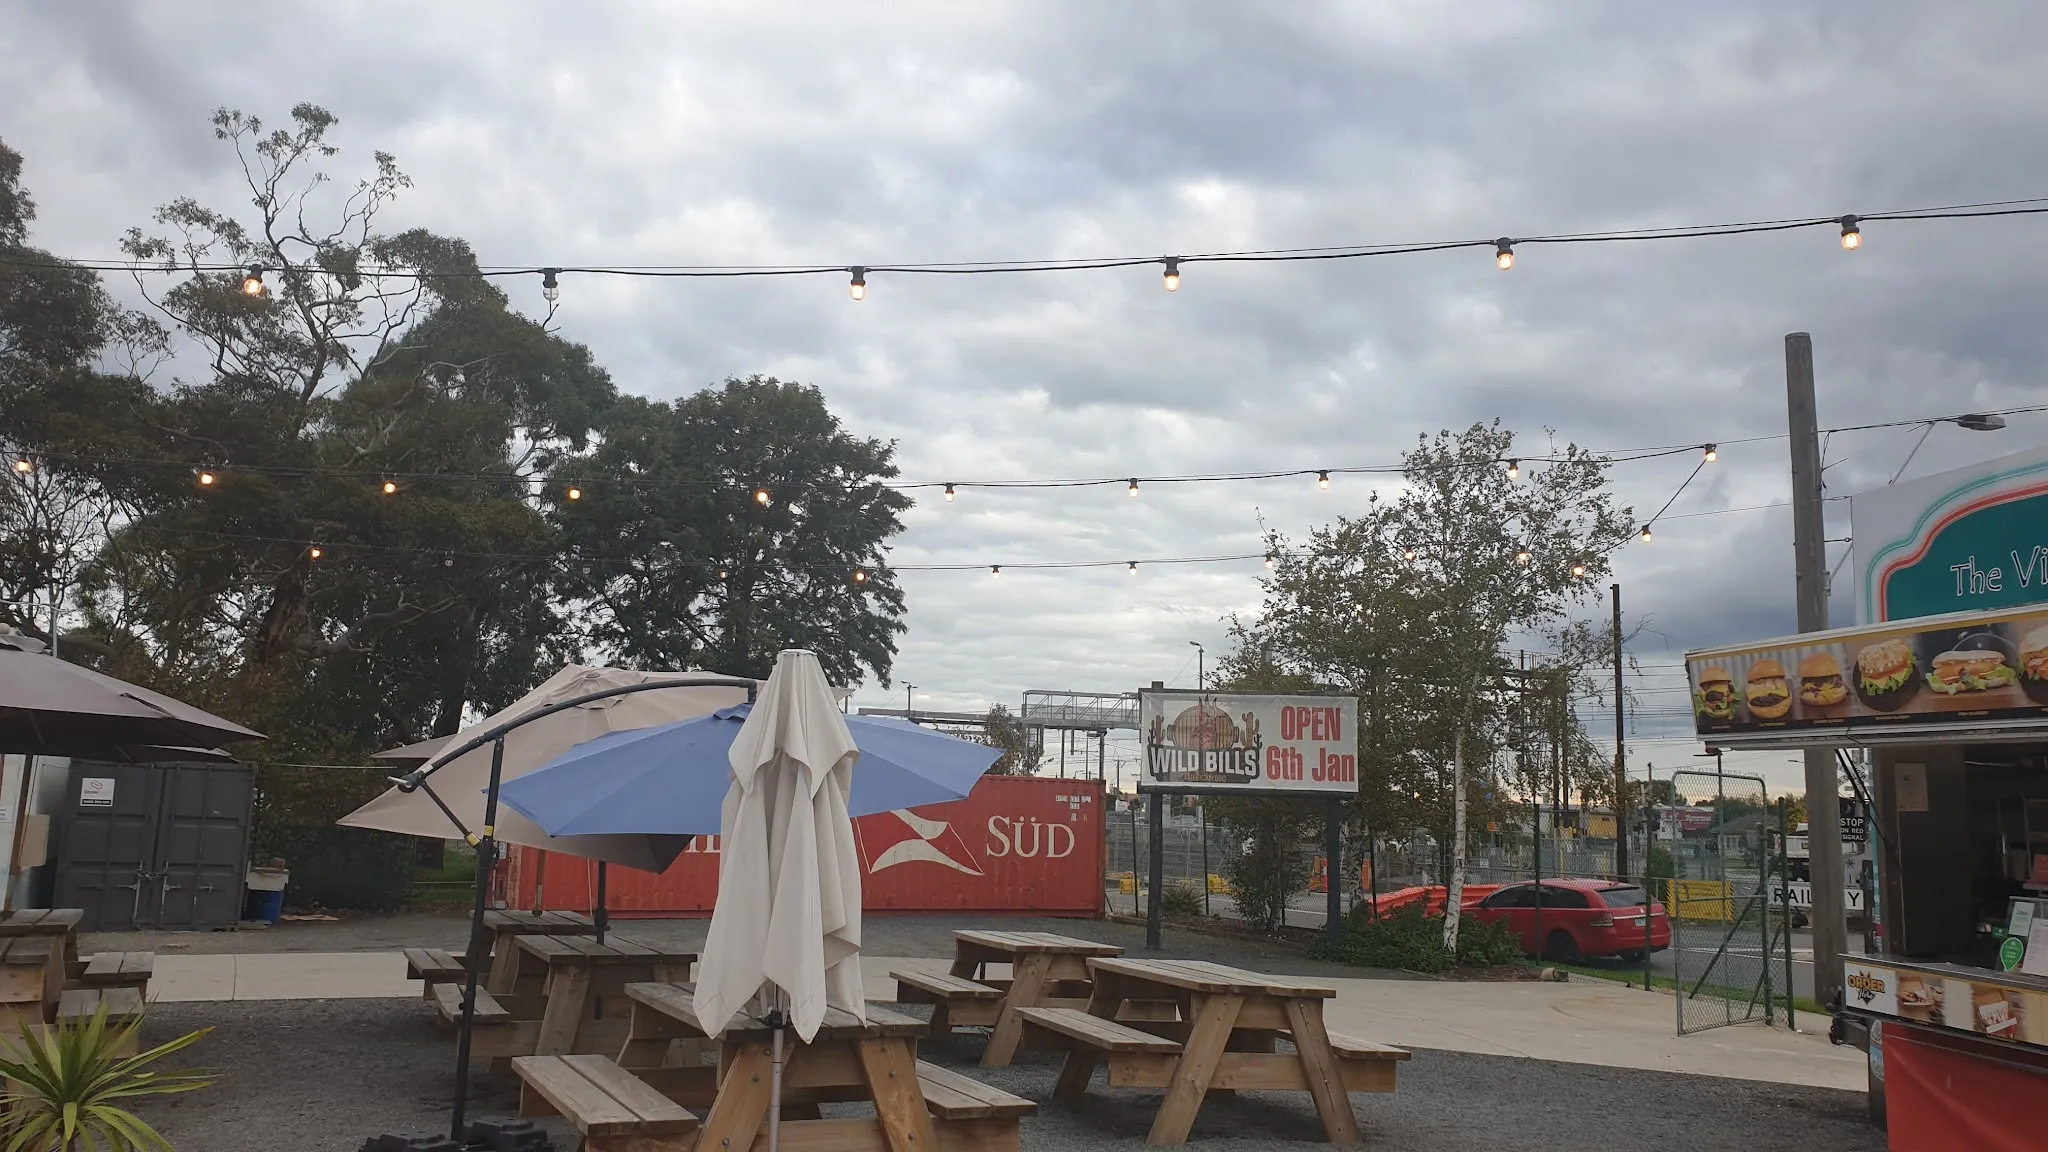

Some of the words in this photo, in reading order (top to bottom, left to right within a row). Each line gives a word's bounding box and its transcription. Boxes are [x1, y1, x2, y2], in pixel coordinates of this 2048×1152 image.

[1950, 555, 2002, 596] The
[1280, 705, 1341, 741] OPEN
[1151, 746, 1199, 773] WILD
[1205, 749, 1257, 777] BILLS
[1266, 745, 1304, 780] 6th
[1312, 748, 1355, 782] Jan
[986, 815, 1075, 858] SÜD
[1840, 818, 1864, 827] STOP
[1773, 887, 1860, 907] RAILY
[1848, 974, 1885, 993] ORDER
